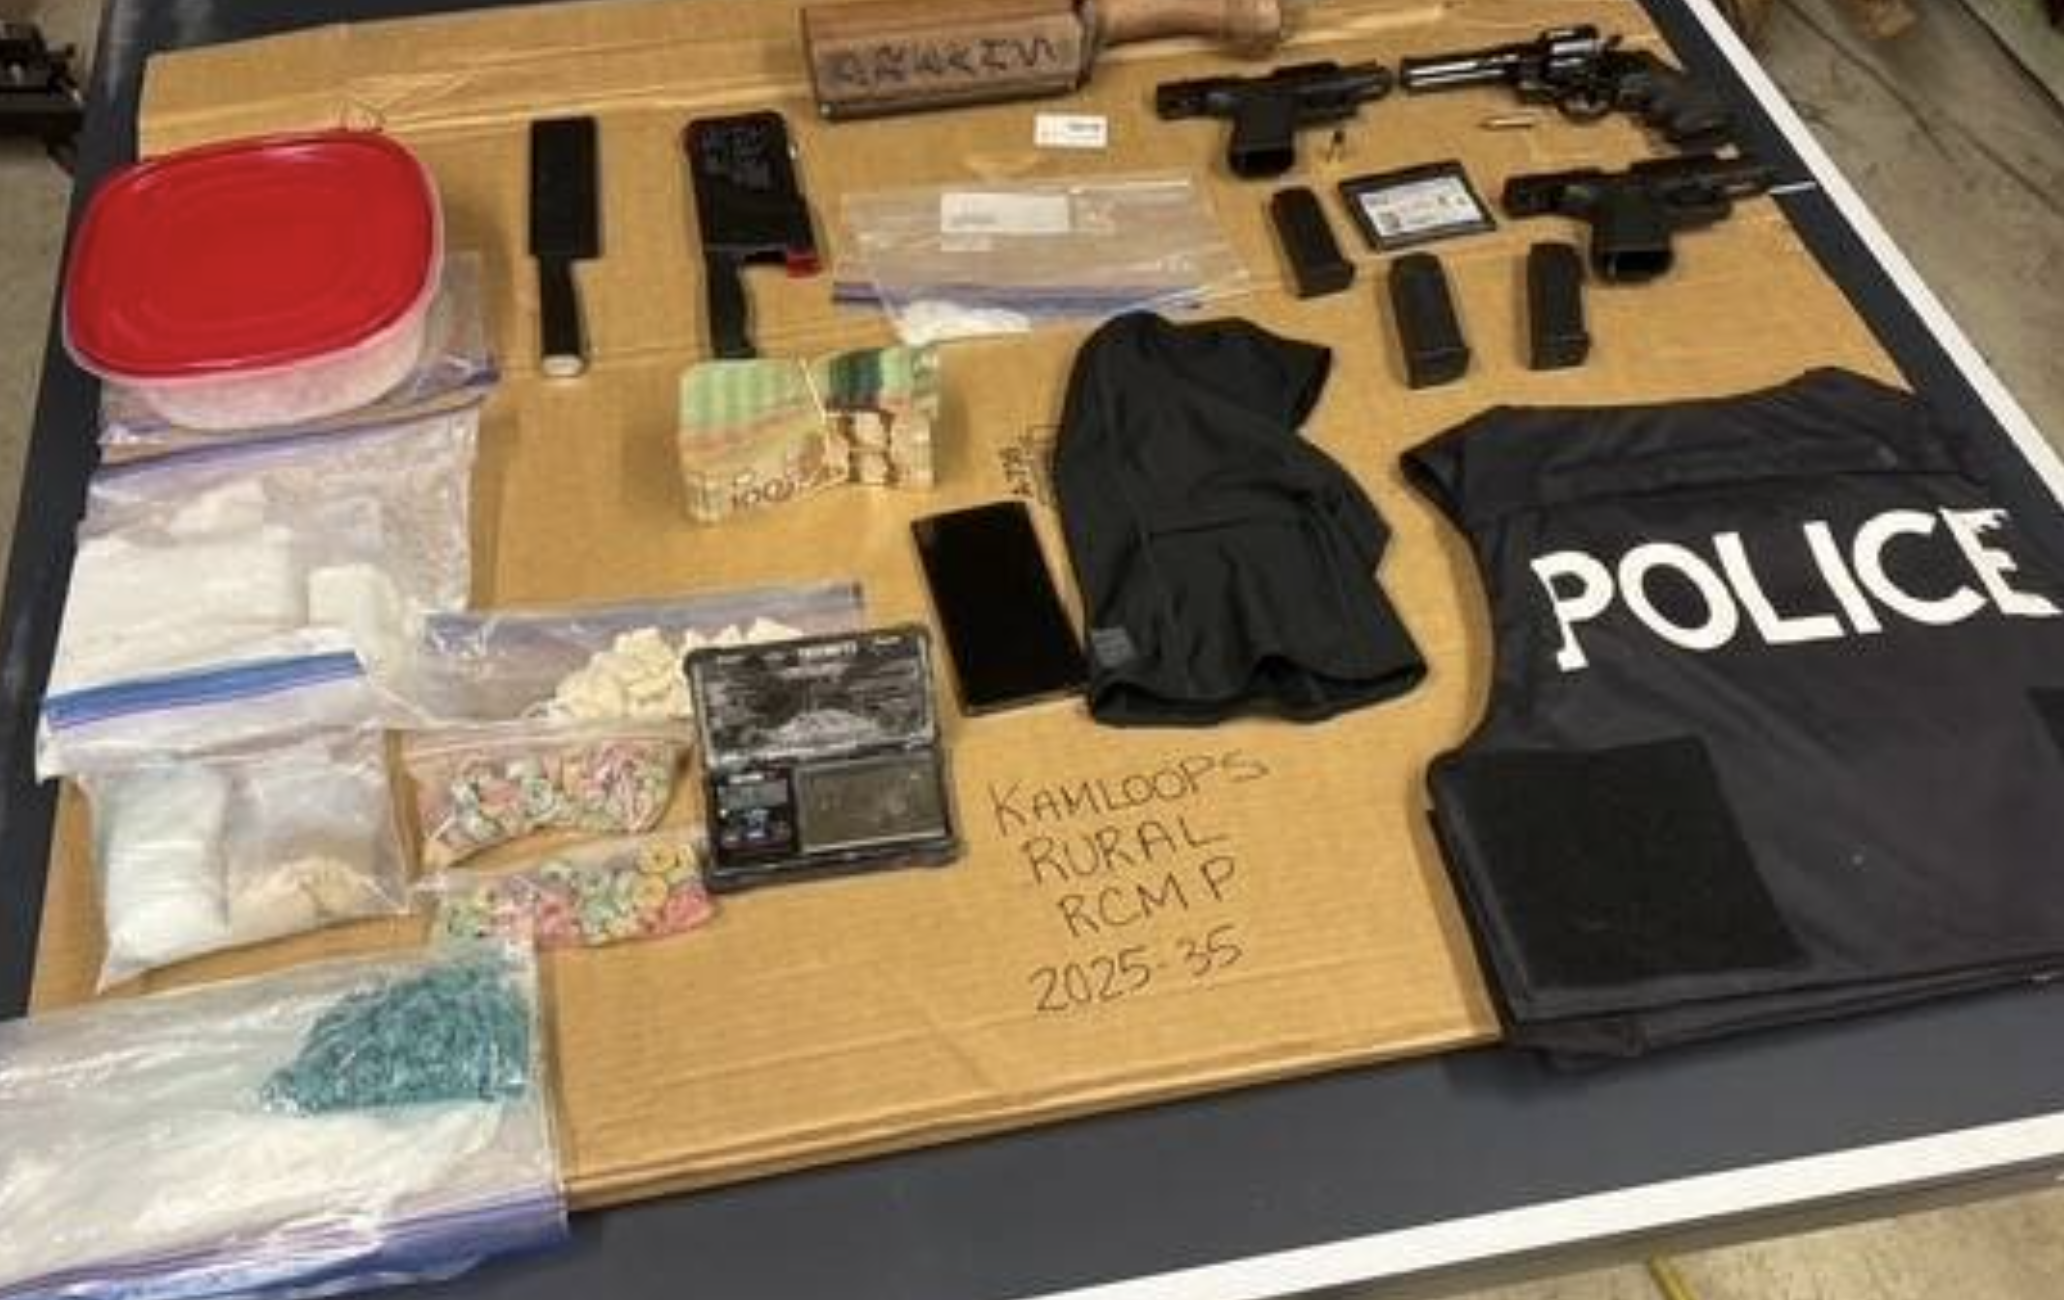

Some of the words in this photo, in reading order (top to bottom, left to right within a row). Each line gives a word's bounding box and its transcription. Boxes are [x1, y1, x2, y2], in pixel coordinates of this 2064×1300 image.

[1530, 507, 2062, 672] POLICE
[988, 750, 1270, 837] KAMLOOPS
[1021, 815, 1230, 884] RURAL
[1028, 923, 1243, 1012] 2025-35
